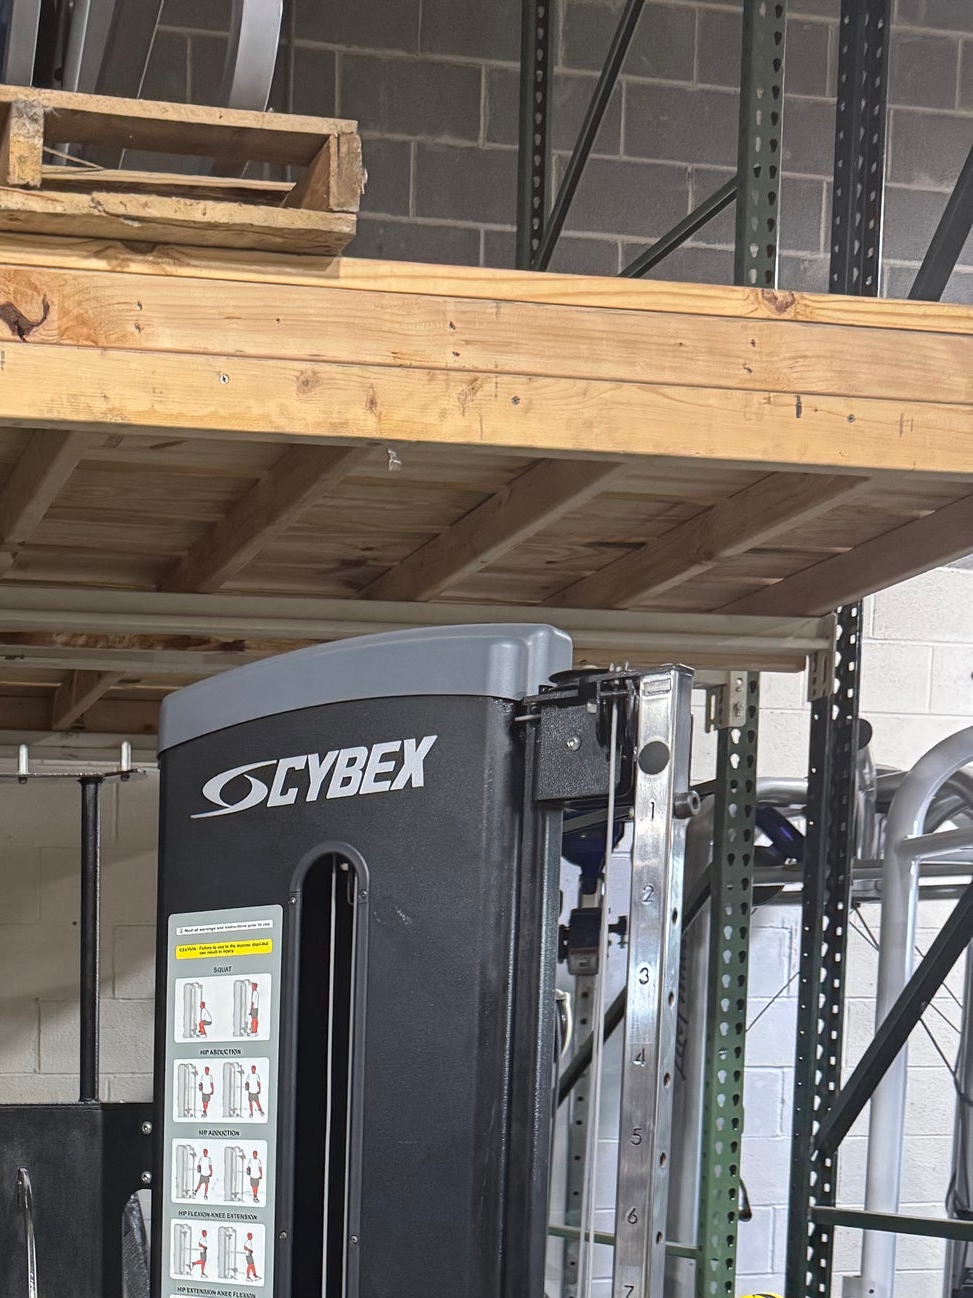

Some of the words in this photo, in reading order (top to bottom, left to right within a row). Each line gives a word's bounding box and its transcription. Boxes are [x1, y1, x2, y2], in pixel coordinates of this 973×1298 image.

[267, 735, 437, 808] CYBEX
[643, 885, 654, 903] 2
[639, 967, 649, 985] 3
[634, 1048, 645, 1065] 4
[631, 1128, 642, 1145] 5
[628, 1208, 638, 1225] 6
